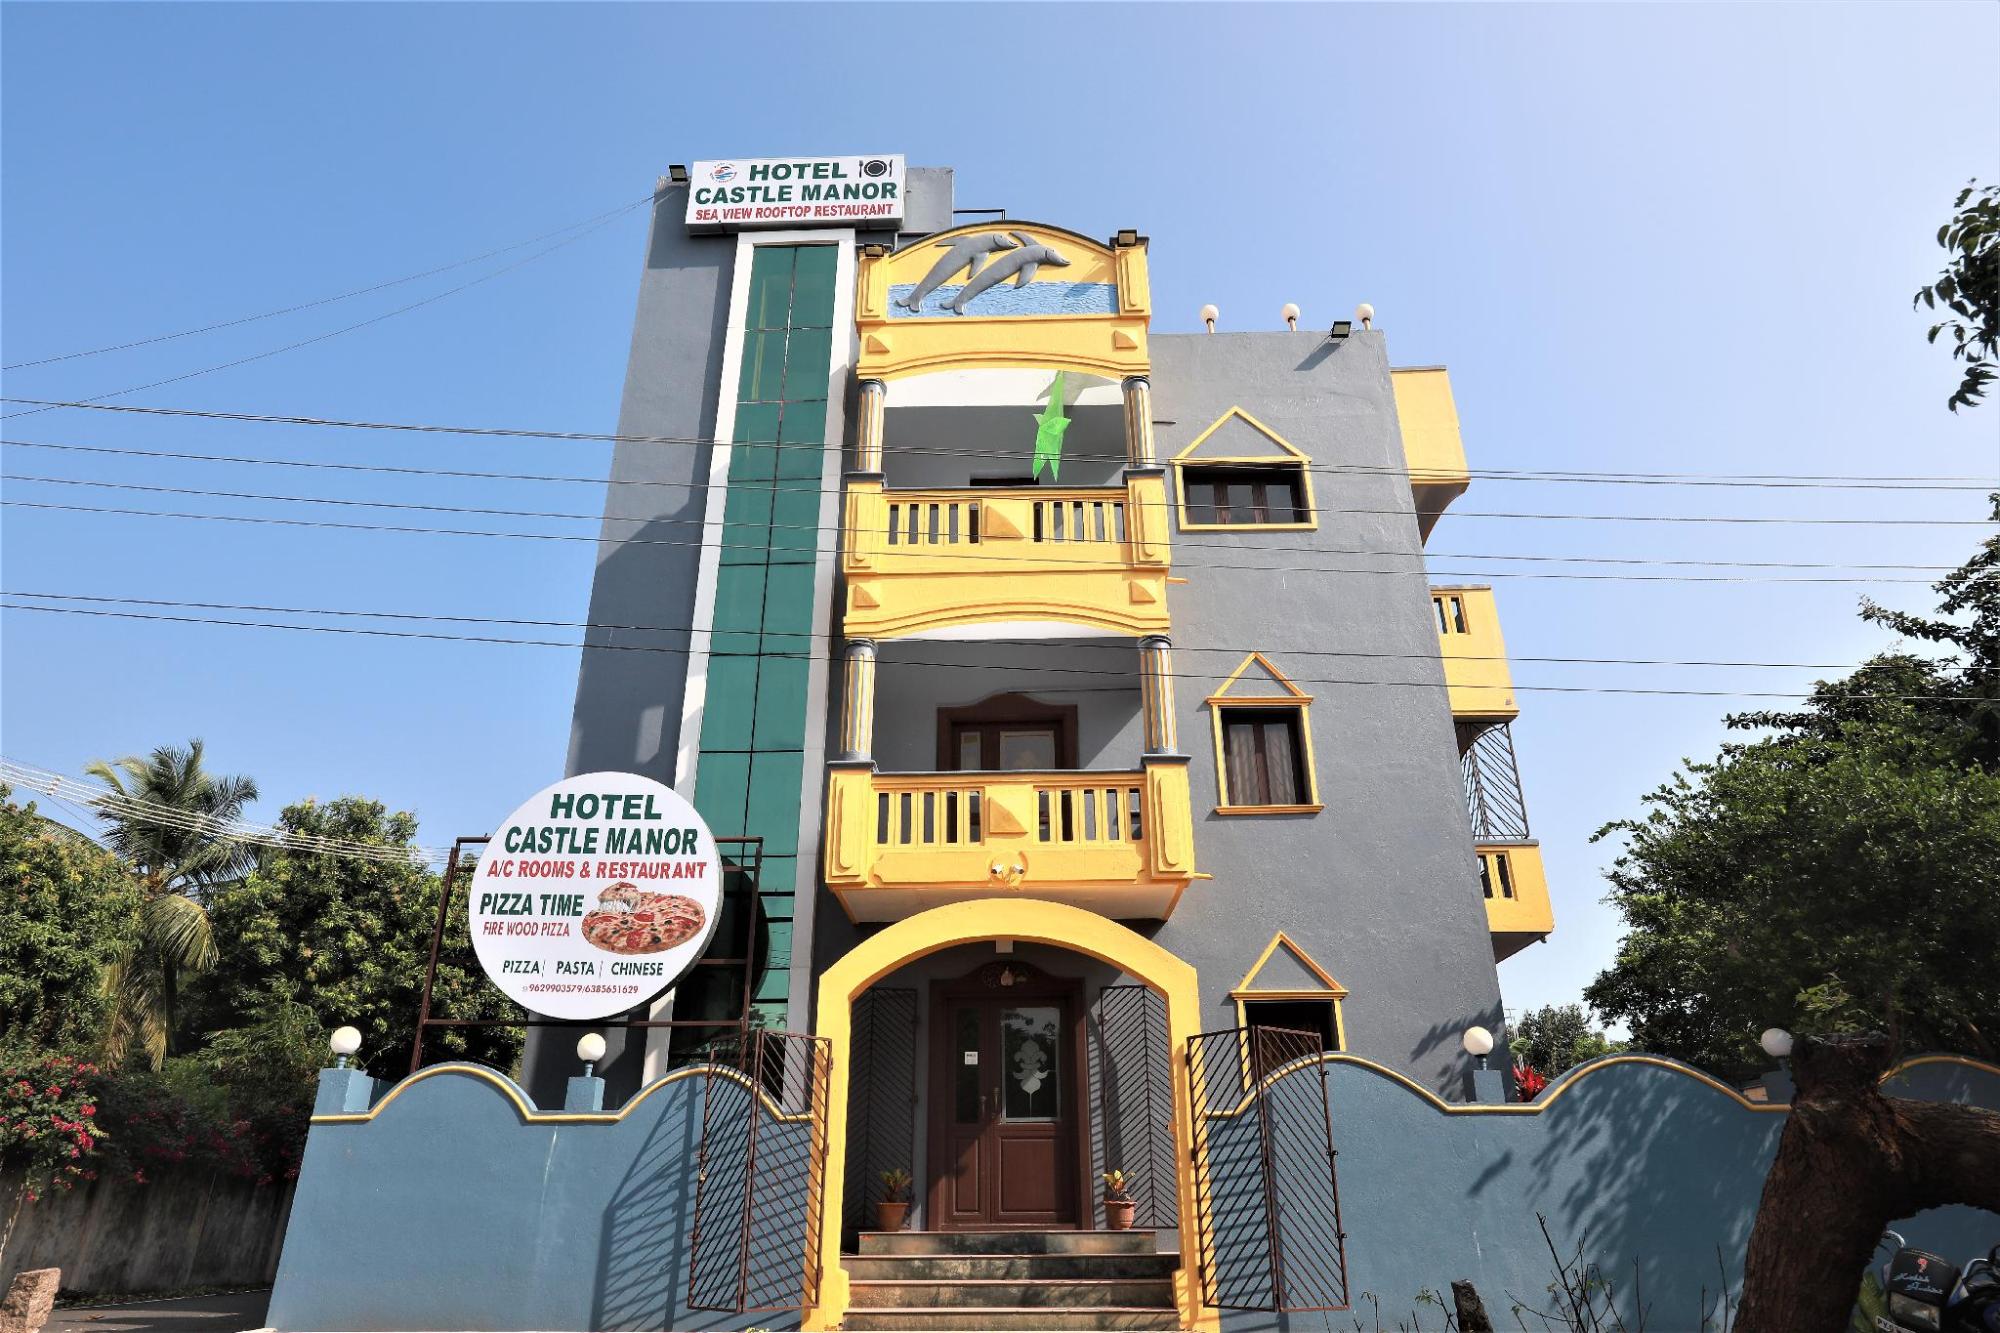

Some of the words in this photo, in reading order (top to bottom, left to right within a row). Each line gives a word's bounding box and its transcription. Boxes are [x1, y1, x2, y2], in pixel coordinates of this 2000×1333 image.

[749, 162, 848, 181] HOTEL
[695, 185, 793, 204] CASTLE
[801, 182, 898, 201] MANOR
[696, 209, 718, 220] SEA
[723, 207, 752, 220] VIEW
[756, 205, 811, 218] ROOFTOP
[814, 203, 893, 217] RESTAURANT
[550, 793, 662, 820] HOTEL
[504, 826, 599, 854] CASTLE
[605, 827, 698, 855] MANOR
[487, 860, 513, 878] A/C
[518, 860, 575, 878] ROOMS
[580, 861, 591, 879] &
[596, 861, 707, 879] RESTAURANT
[479, 893, 532, 916] PIZZA
[540, 893, 584, 917] TIME
[483, 921, 504, 936] FIRE
[506, 921, 538, 937] WOOD
[541, 922, 570, 937] PIZZA
[502, 960, 540, 974] PIZZA
[556, 961, 595, 976] PASTA
[611, 961, 664, 976] CHINESE
